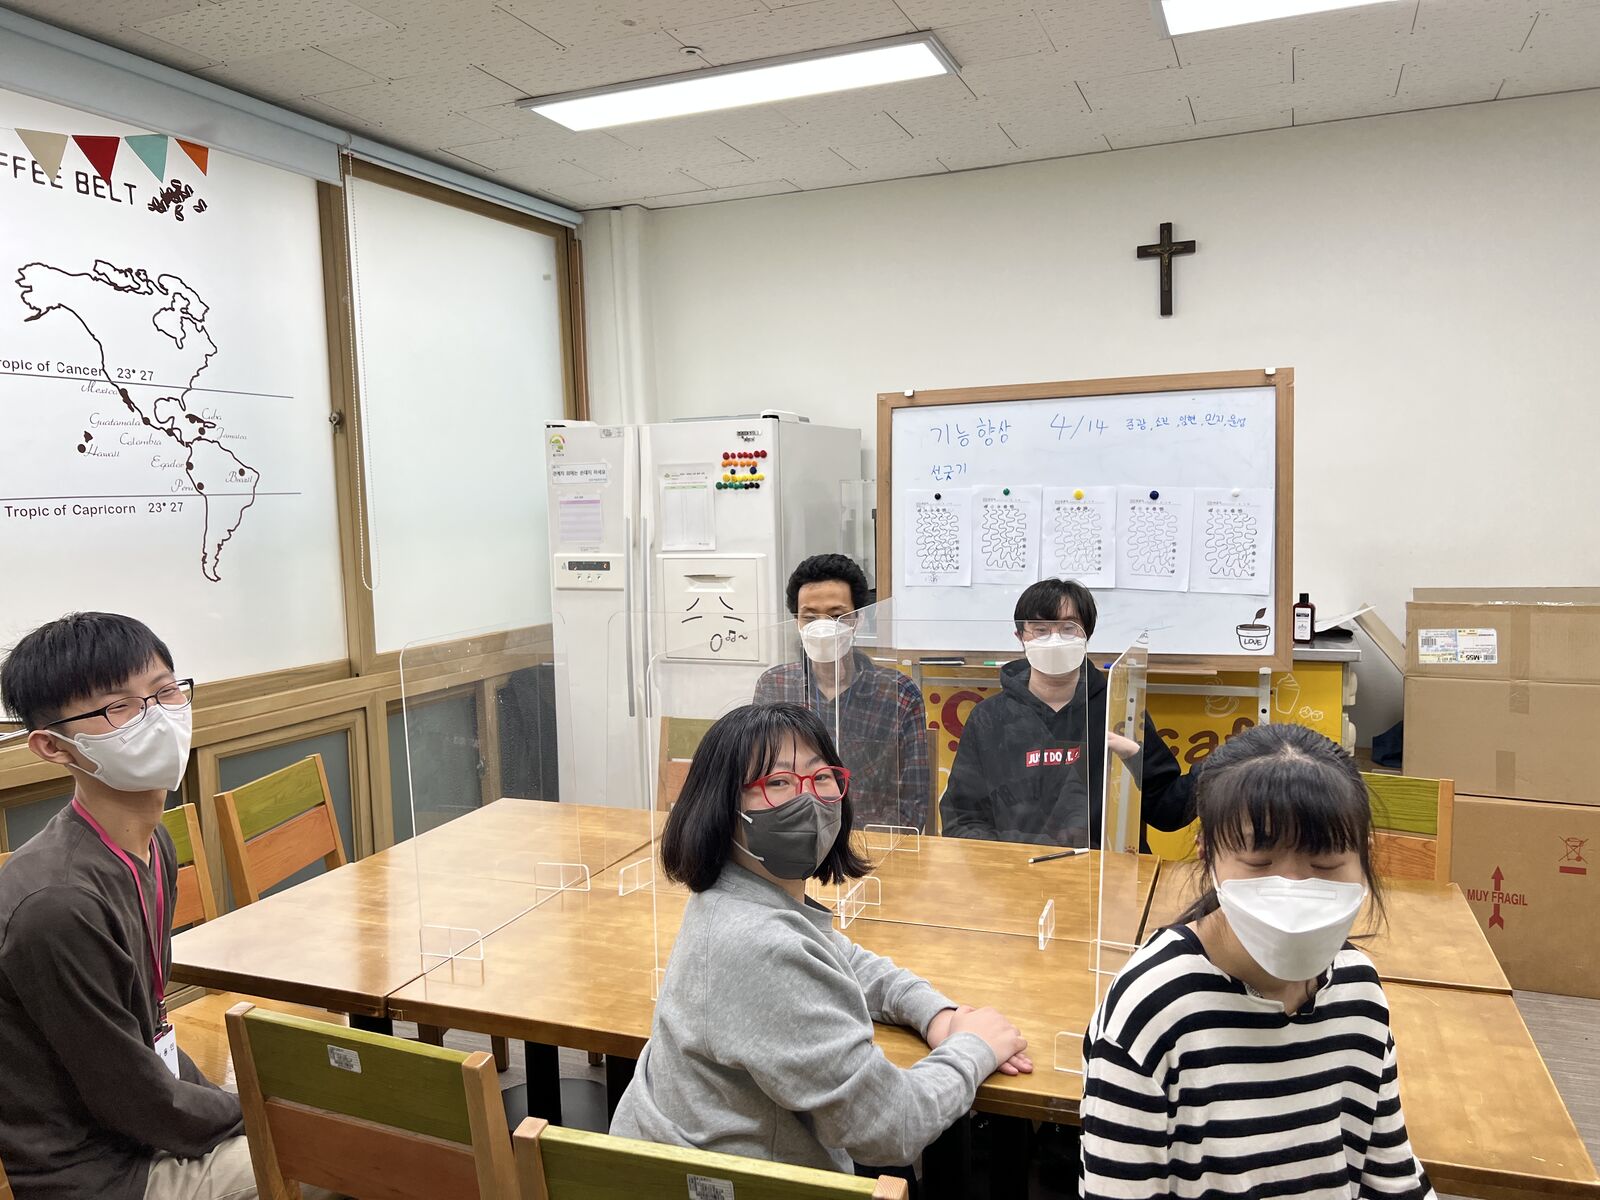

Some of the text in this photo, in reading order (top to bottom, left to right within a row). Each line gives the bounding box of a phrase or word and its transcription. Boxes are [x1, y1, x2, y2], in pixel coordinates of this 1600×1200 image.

[75, 170, 137, 205] BELT
[0, 359, 33, 372] opic
[37, 361, 50, 372] of
[57, 361, 103, 376] Cancer
[140, 370, 154, 381] 27
[80, 380, 118, 395] Mexico
[1050, 413, 1109, 440] 4/14
[225, 471, 253, 483] Brazil
[171, 478, 194, 493] Peru
[4, 505, 50, 520] Tropic
[54, 504, 67, 516] of
[72, 503, 137, 518] Capricorn
[170, 502, 184, 512] 27
[1244, 638, 1263, 646] LOVE
[1028, 752, 1049, 765] JUT
[1049, 751, 1063, 763] DO
[1467, 888, 1528, 906] MUY FRAGIL
